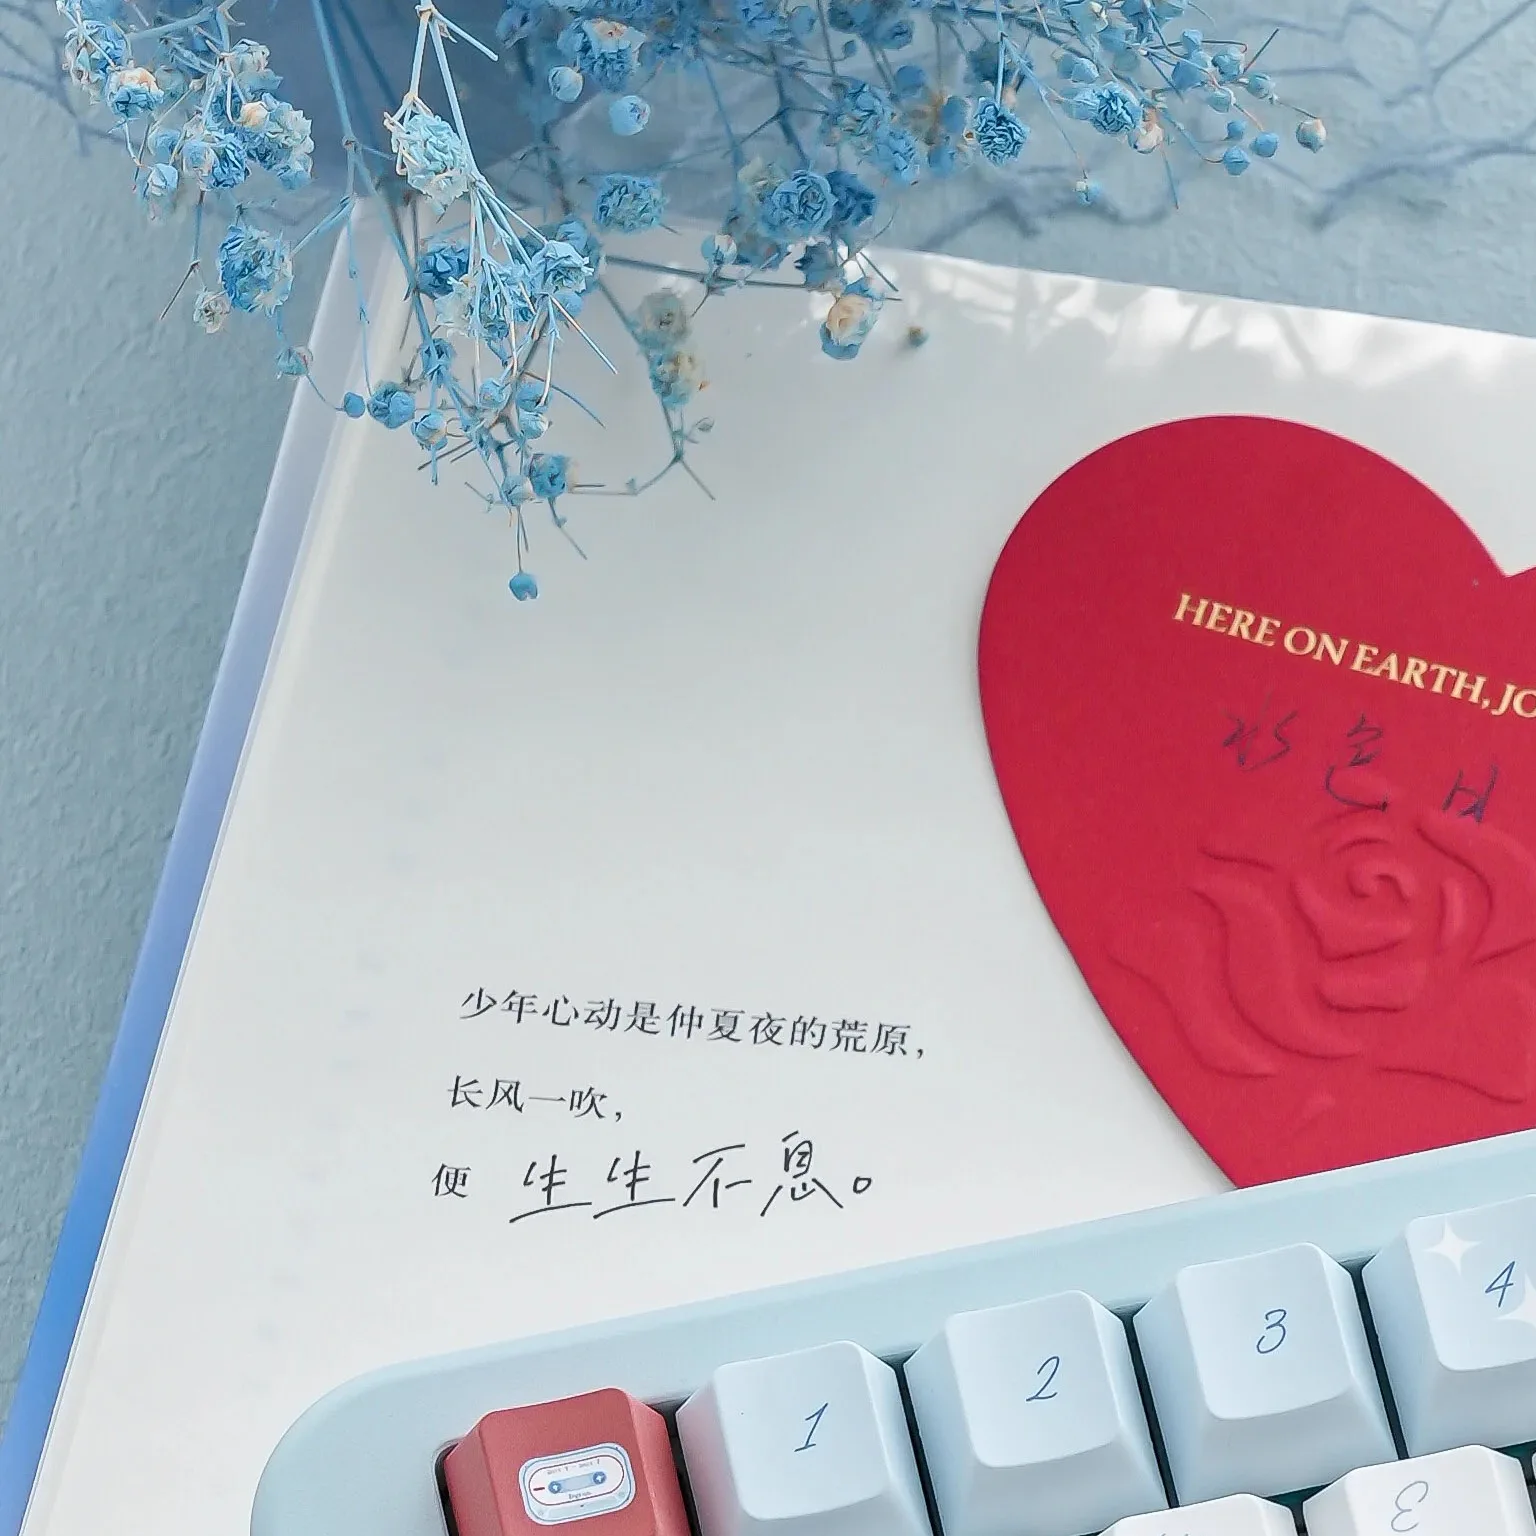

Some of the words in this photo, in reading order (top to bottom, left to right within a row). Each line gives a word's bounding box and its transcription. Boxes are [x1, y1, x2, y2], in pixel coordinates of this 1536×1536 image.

[1173, 593, 1282, 648] HERE
[1283, 626, 1349, 667] ON
[1350, 643, 1492, 710] EARTH,
[430, 1162, 472, 1199] 便
[1484, 1260, 1516, 1309] 4
[1255, 1308, 1288, 1355] 3
[1025, 1355, 1061, 1403] 2
[793, 1401, 829, 1453] 1
